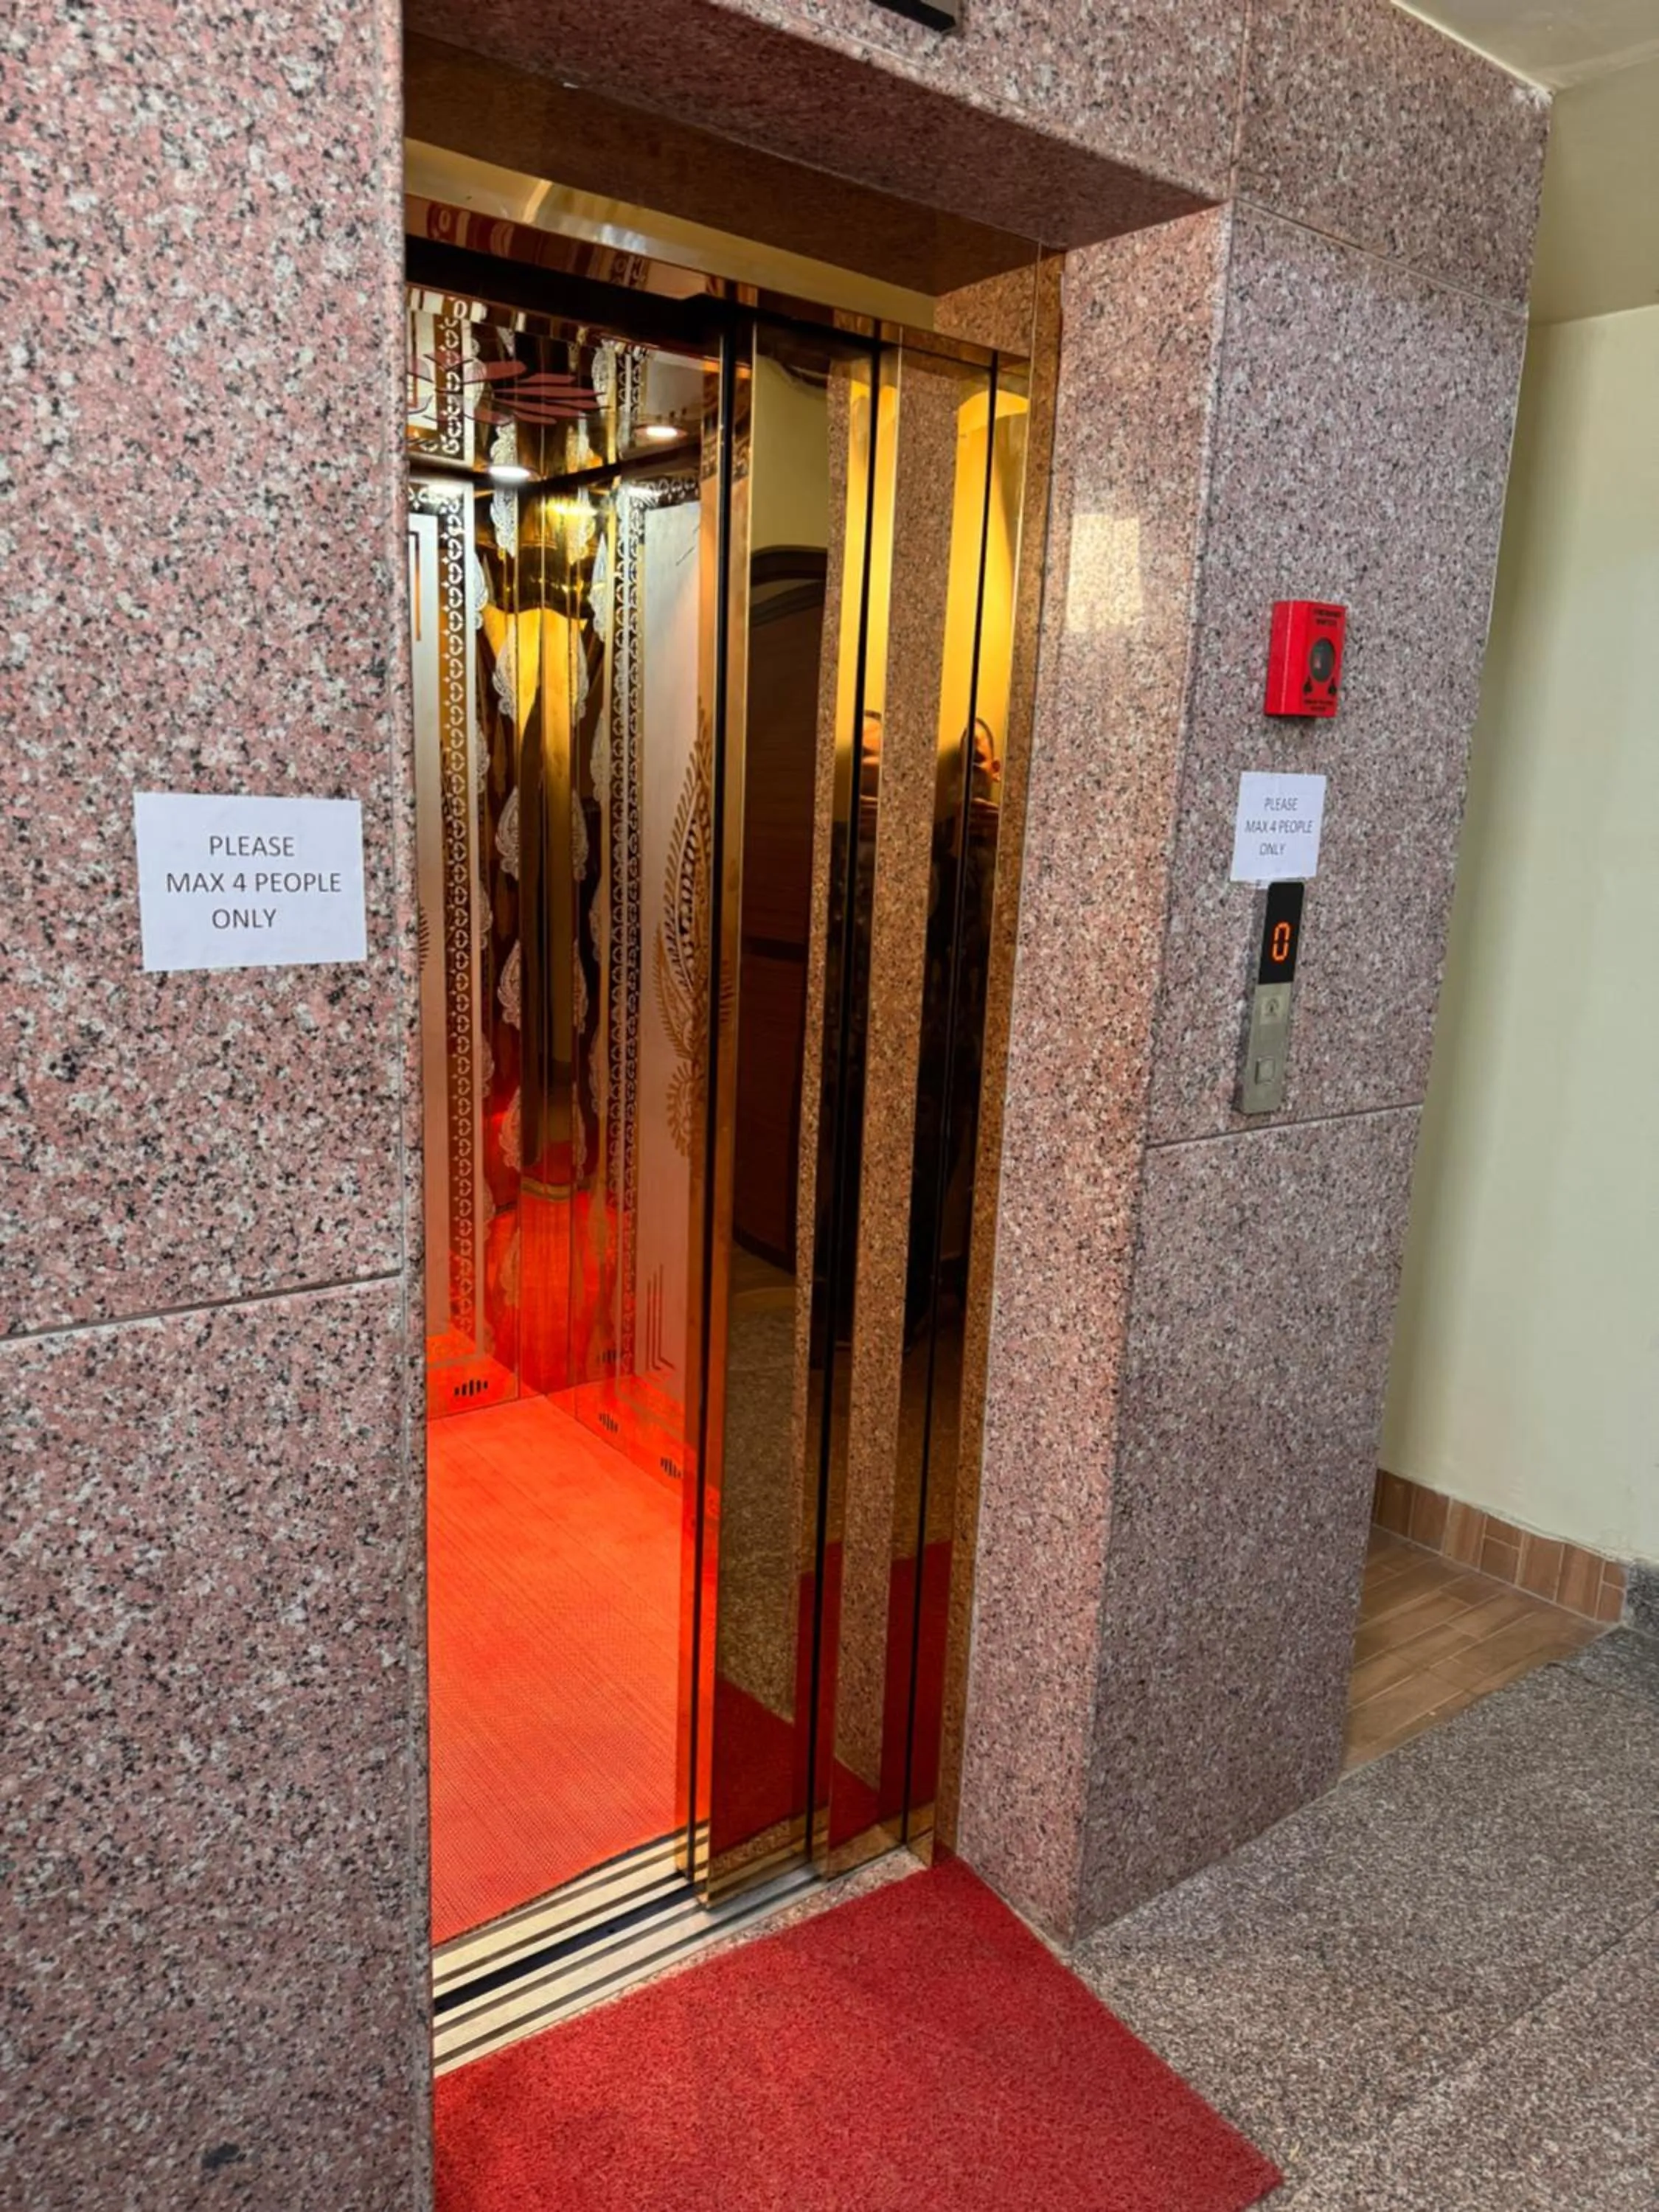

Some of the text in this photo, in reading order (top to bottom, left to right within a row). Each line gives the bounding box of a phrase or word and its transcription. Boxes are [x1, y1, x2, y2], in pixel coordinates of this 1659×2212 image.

[1264, 797, 1298, 811] PLEASE
[1245, 820, 1314, 833] MAX 4 PEOPLE
[209, 835, 295, 857] PLEASE
[1259, 843, 1286, 855] ONLY
[166, 872, 342, 893] MAX 4 PEOPLE
[212, 908, 276, 929] ONLY
[1272, 922, 1290, 961] 0
